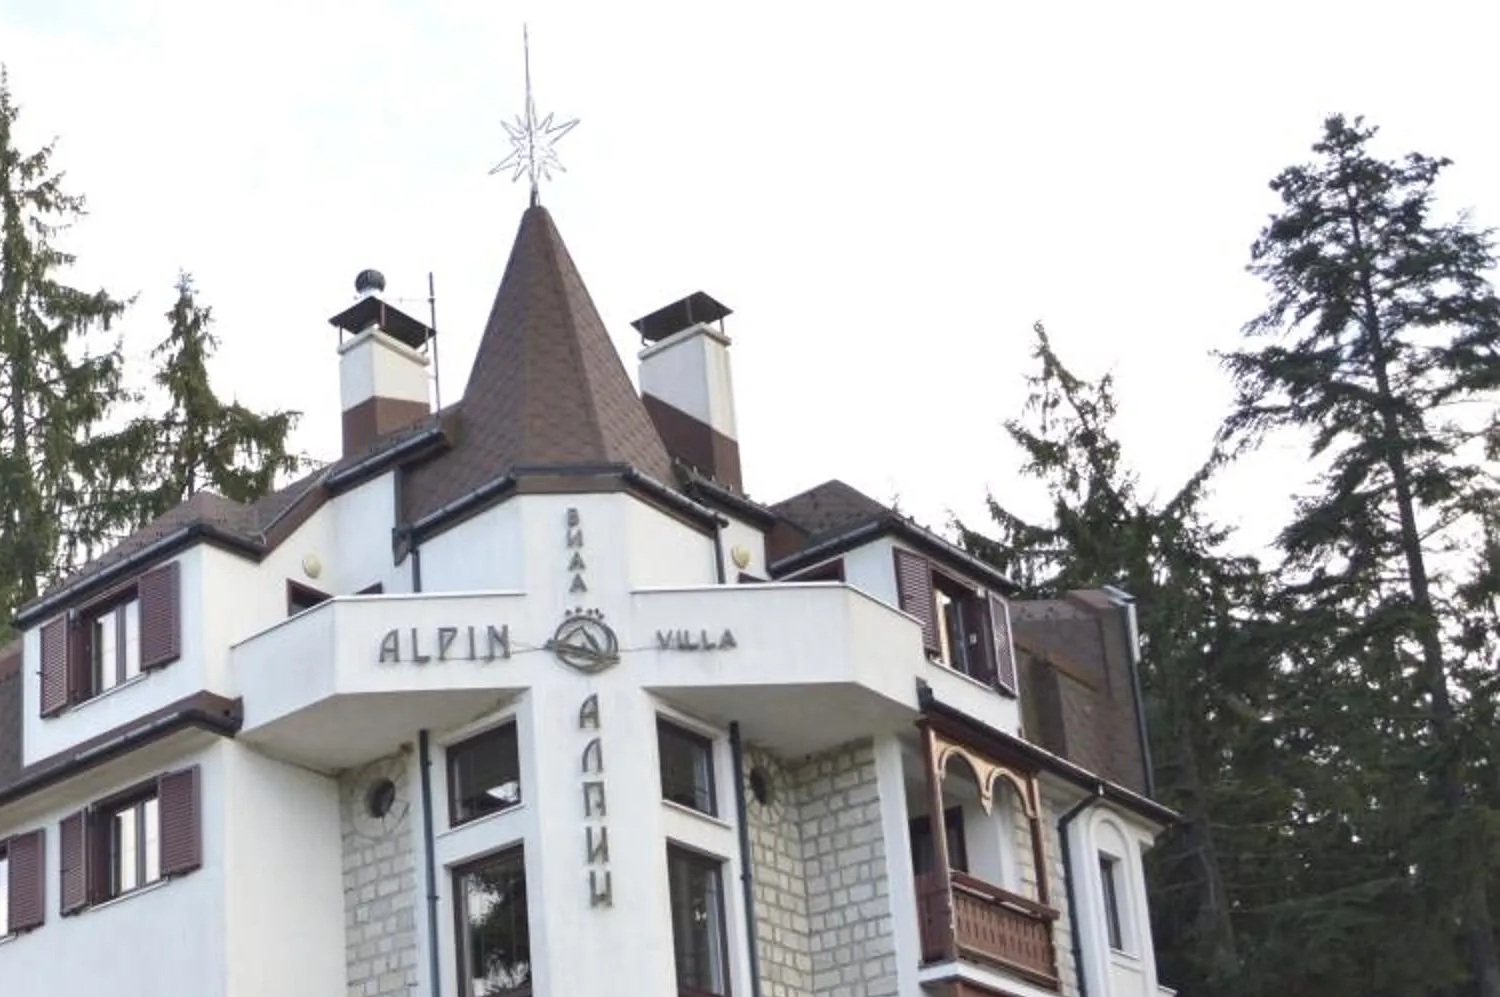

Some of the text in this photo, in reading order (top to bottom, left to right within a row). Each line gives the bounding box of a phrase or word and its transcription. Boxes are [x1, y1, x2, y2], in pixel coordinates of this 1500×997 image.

[566, 507, 588, 593] ВИЛА
[379, 623, 738, 664] ALPIN VILLA
